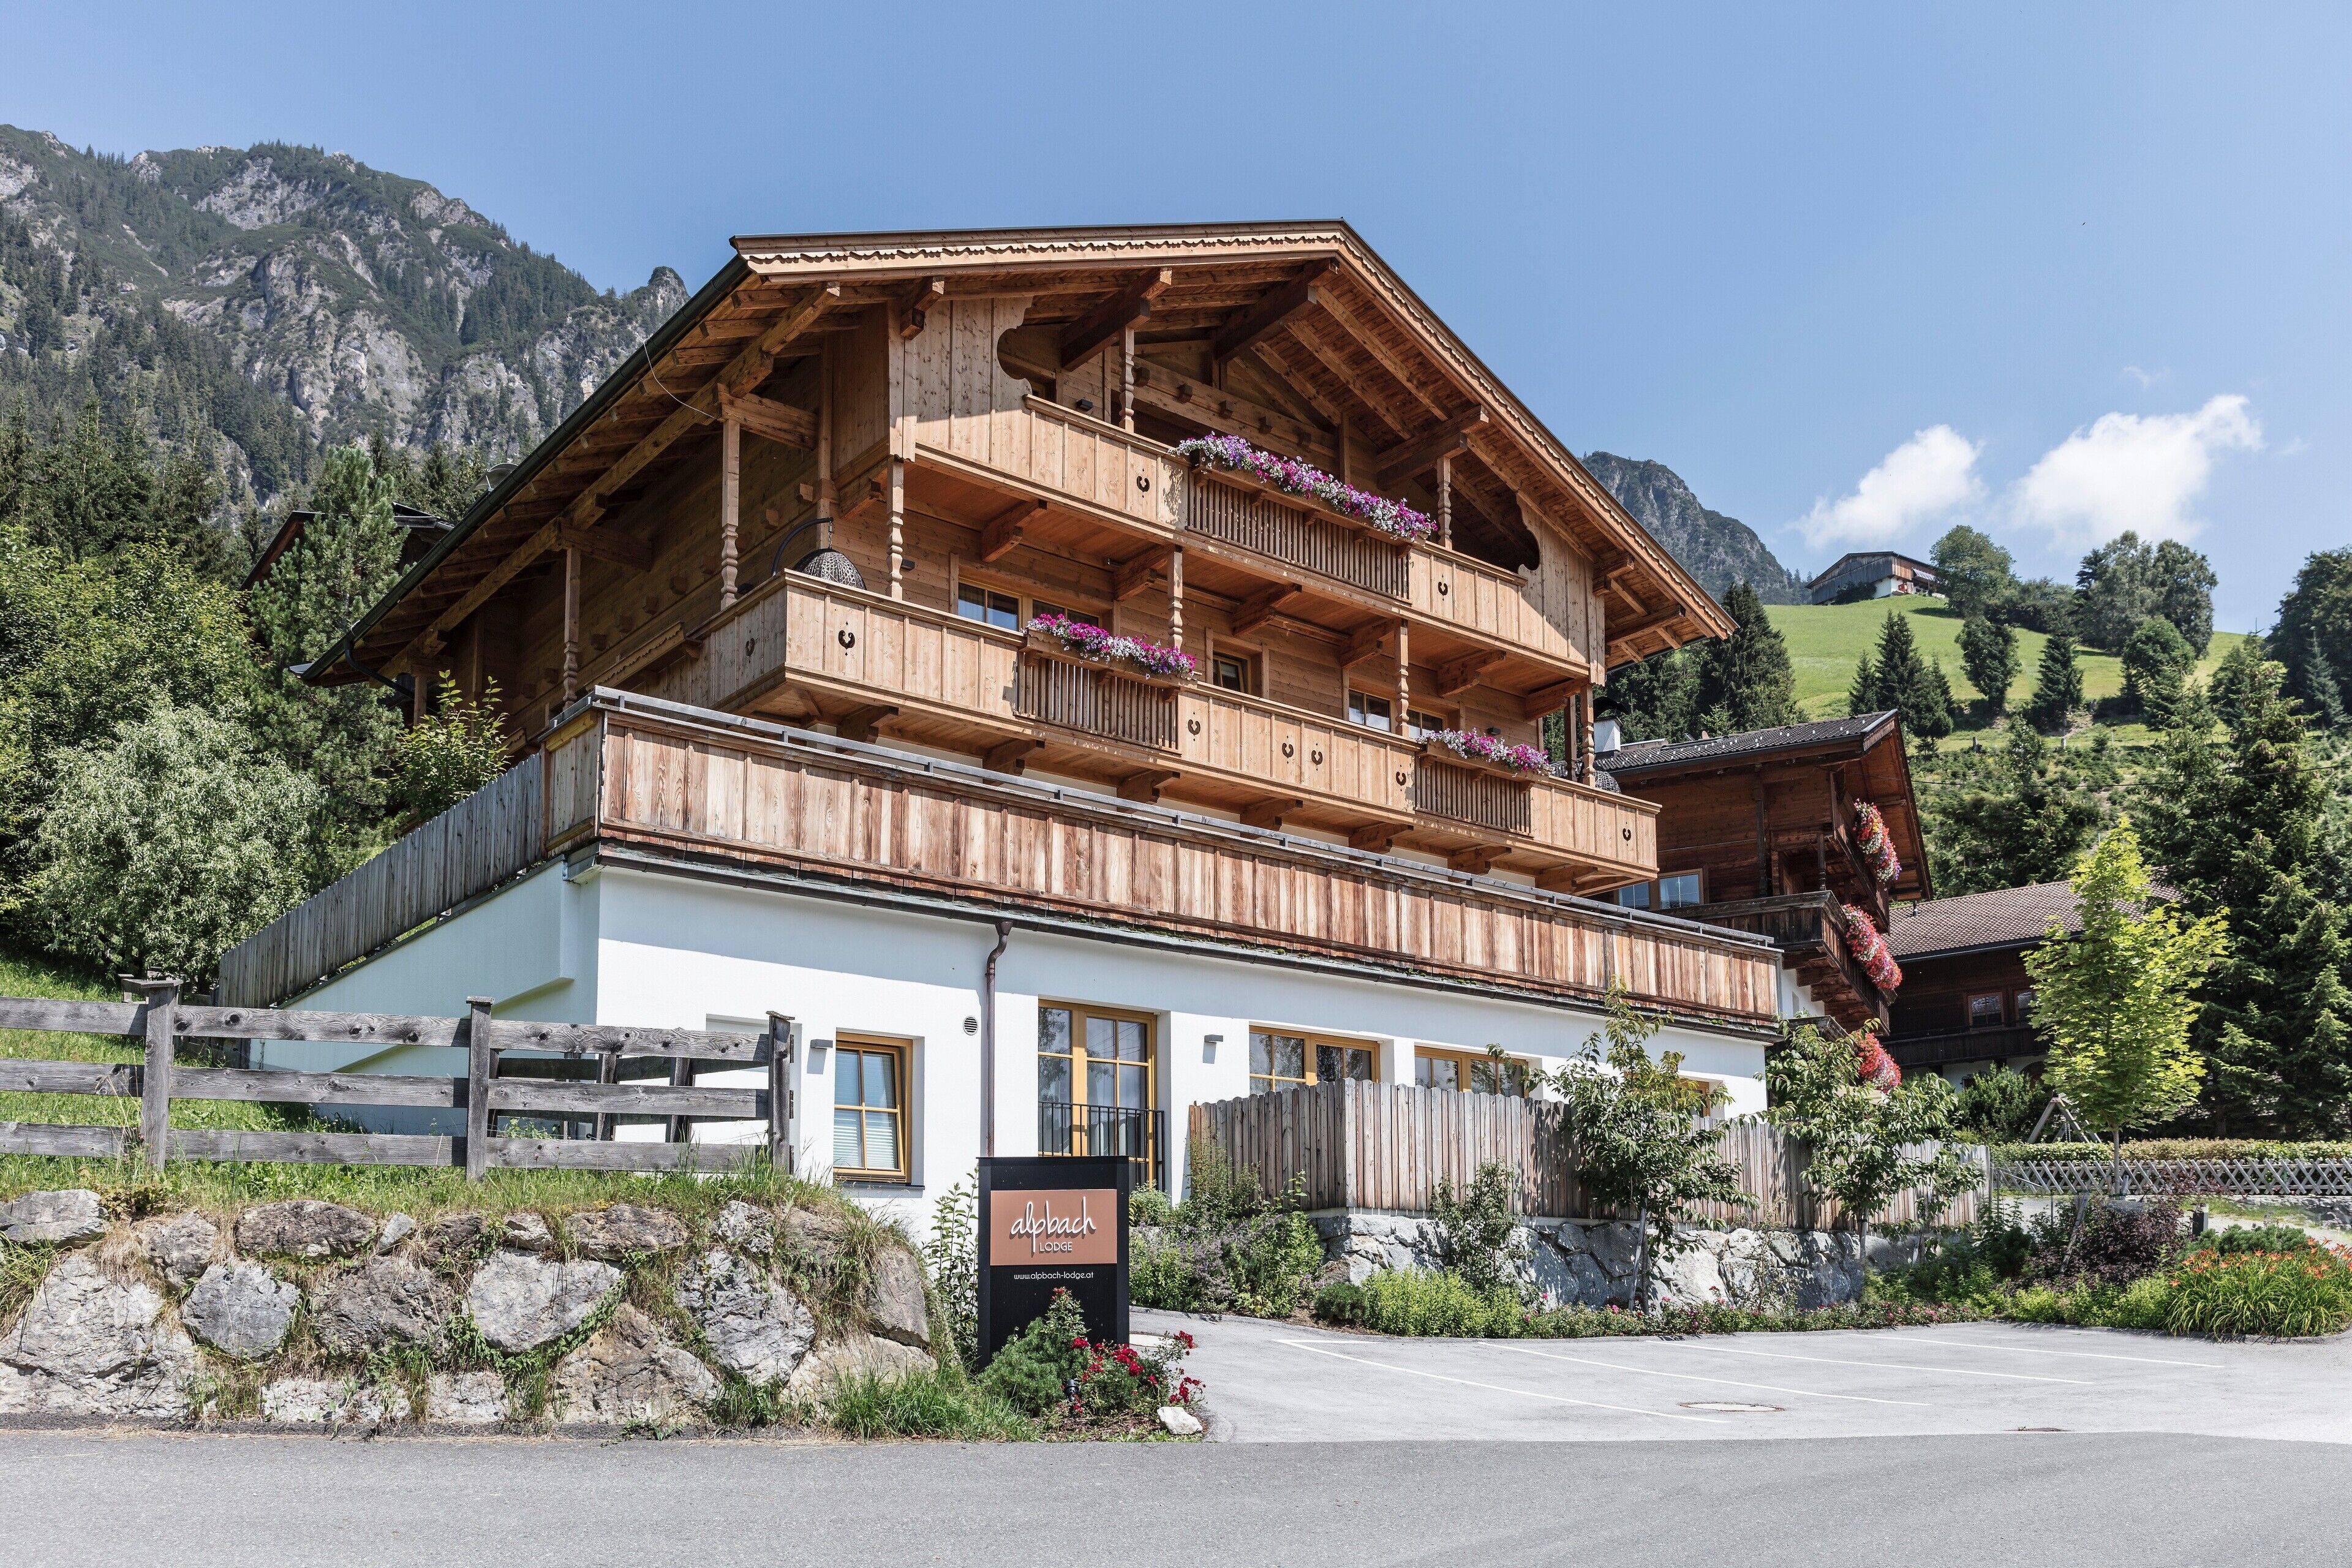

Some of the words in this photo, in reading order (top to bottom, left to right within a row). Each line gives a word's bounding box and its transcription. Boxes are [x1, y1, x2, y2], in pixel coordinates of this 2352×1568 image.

[1011, 1196, 1096, 1253] alpbach
[1039, 1242, 1073, 1252] LODGE
[1014, 1271, 1094, 1280] www.alpbach-lodge.at
